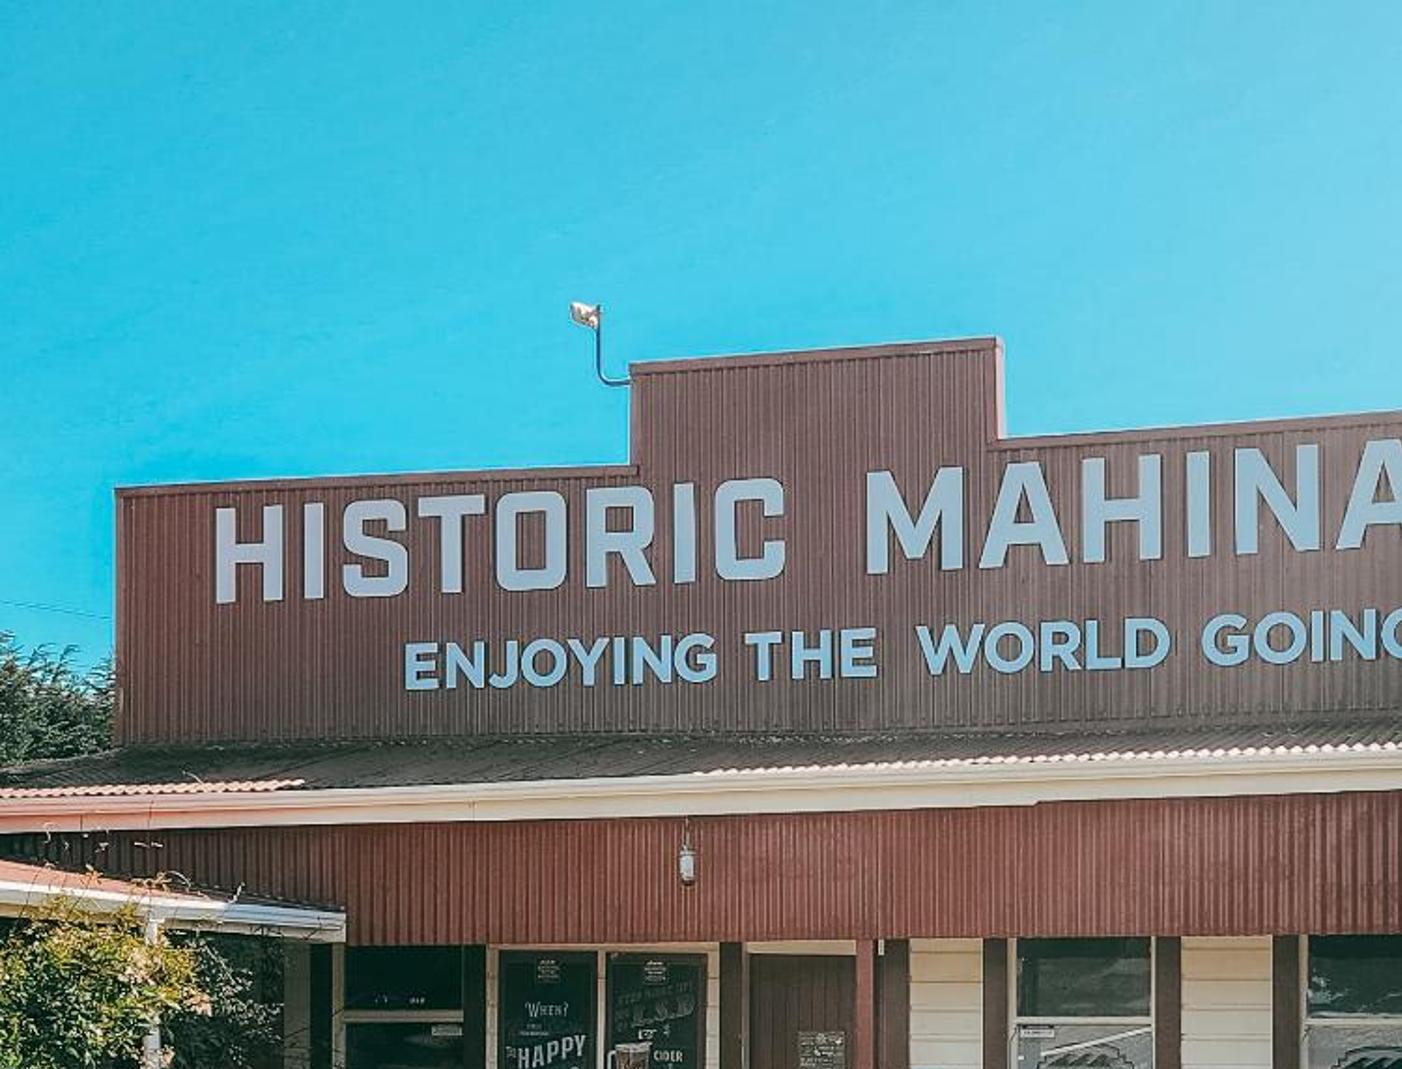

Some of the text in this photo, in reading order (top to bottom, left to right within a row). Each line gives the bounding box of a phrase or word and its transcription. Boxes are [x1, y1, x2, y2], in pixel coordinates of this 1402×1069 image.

[215, 477, 787, 605] HISTORIC
[404, 631, 718, 691] ENJOYING
[744, 626, 878, 681] THE
[915, 616, 1172, 676] WORLD
[517, 1034, 587, 1069] HAPPY
[653, 1049, 684, 1062] CIDER
